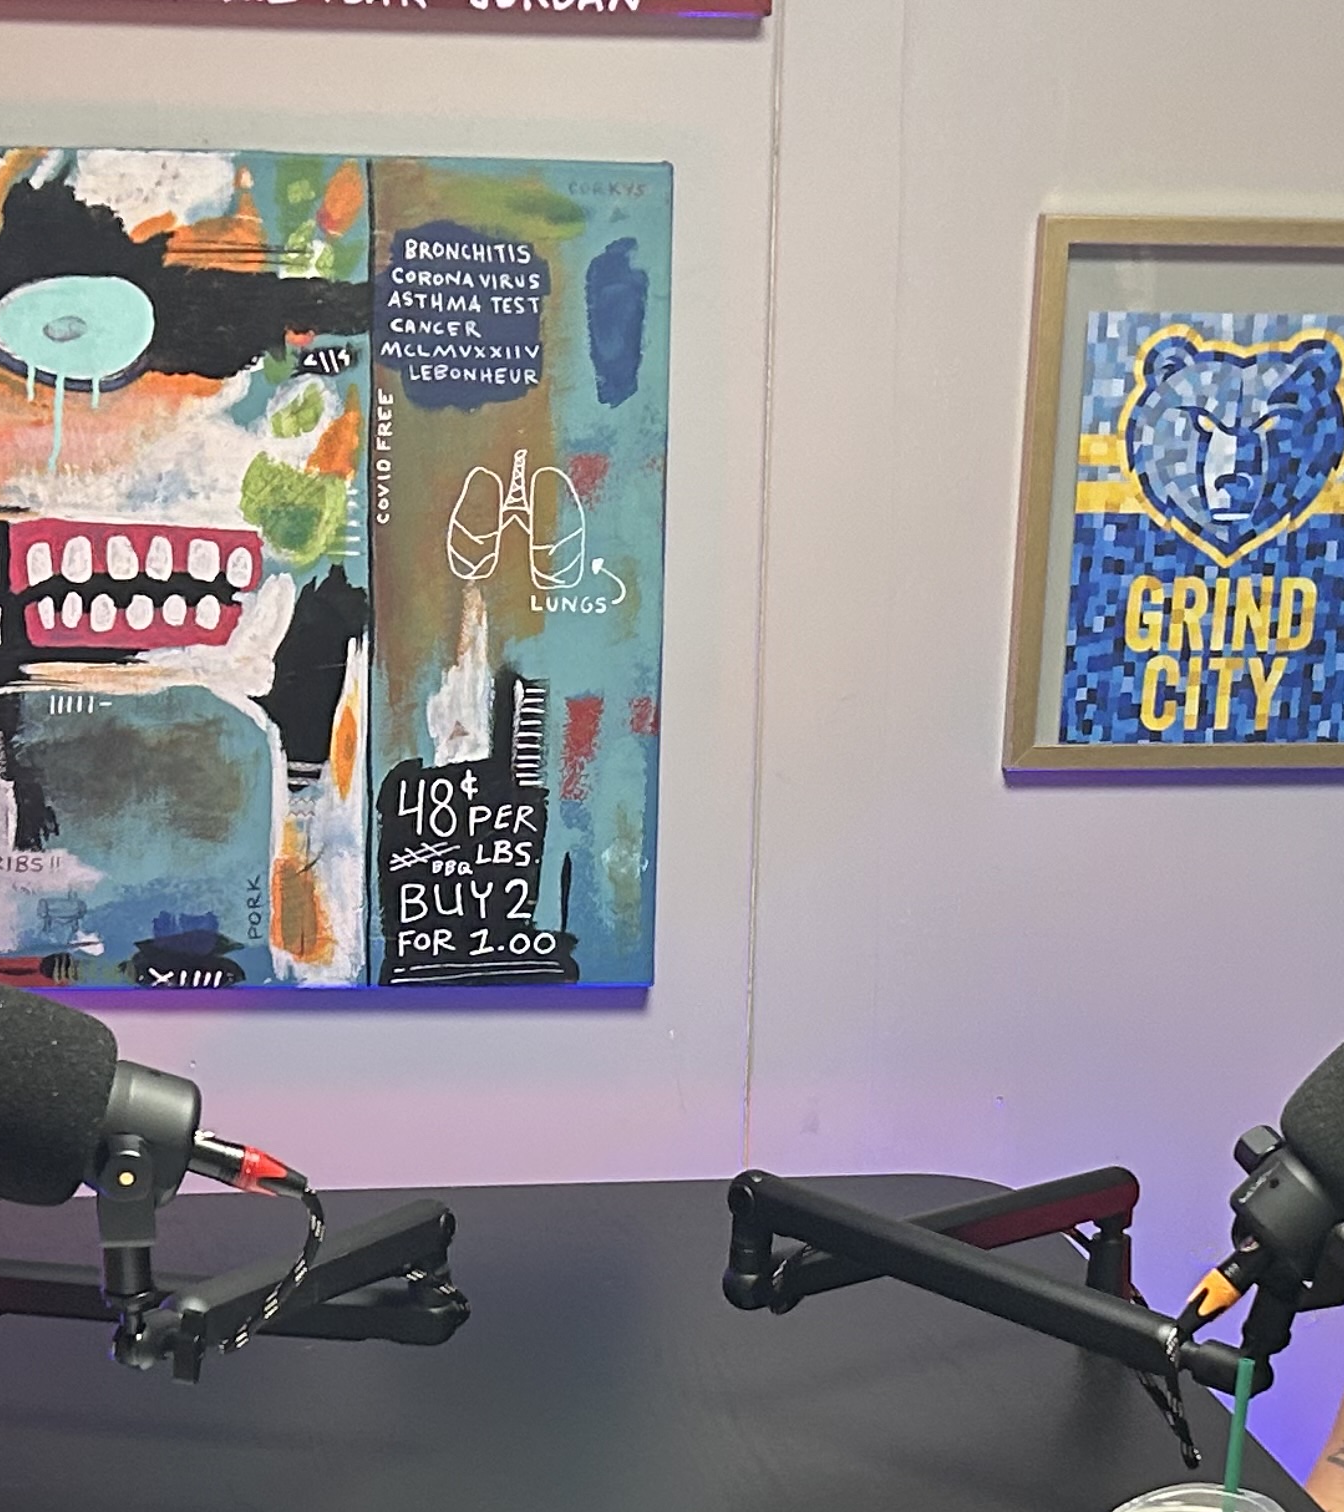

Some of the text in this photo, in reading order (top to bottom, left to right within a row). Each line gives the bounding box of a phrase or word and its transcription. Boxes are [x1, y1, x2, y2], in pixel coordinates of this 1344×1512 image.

[404, 238, 531, 264] BRONCHITIS
[387, 290, 540, 314] ASTHMA TEST
[390, 318, 481, 338] CANCER
[408, 364, 540, 385] LEBONHEUR
[376, 388, 394, 524] COVID FREE
[531, 595, 607, 613] LUNGS
[1124, 574, 1317, 652] GRIND
[1140, 654, 1288, 731] CITY
[469, 804, 538, 836] PER
[475, 840, 540, 867] LBS.
[247, 874, 261, 939] PORK
[399, 878, 533, 924] BUY 2
[398, 928, 556, 957] FOR 1.00
